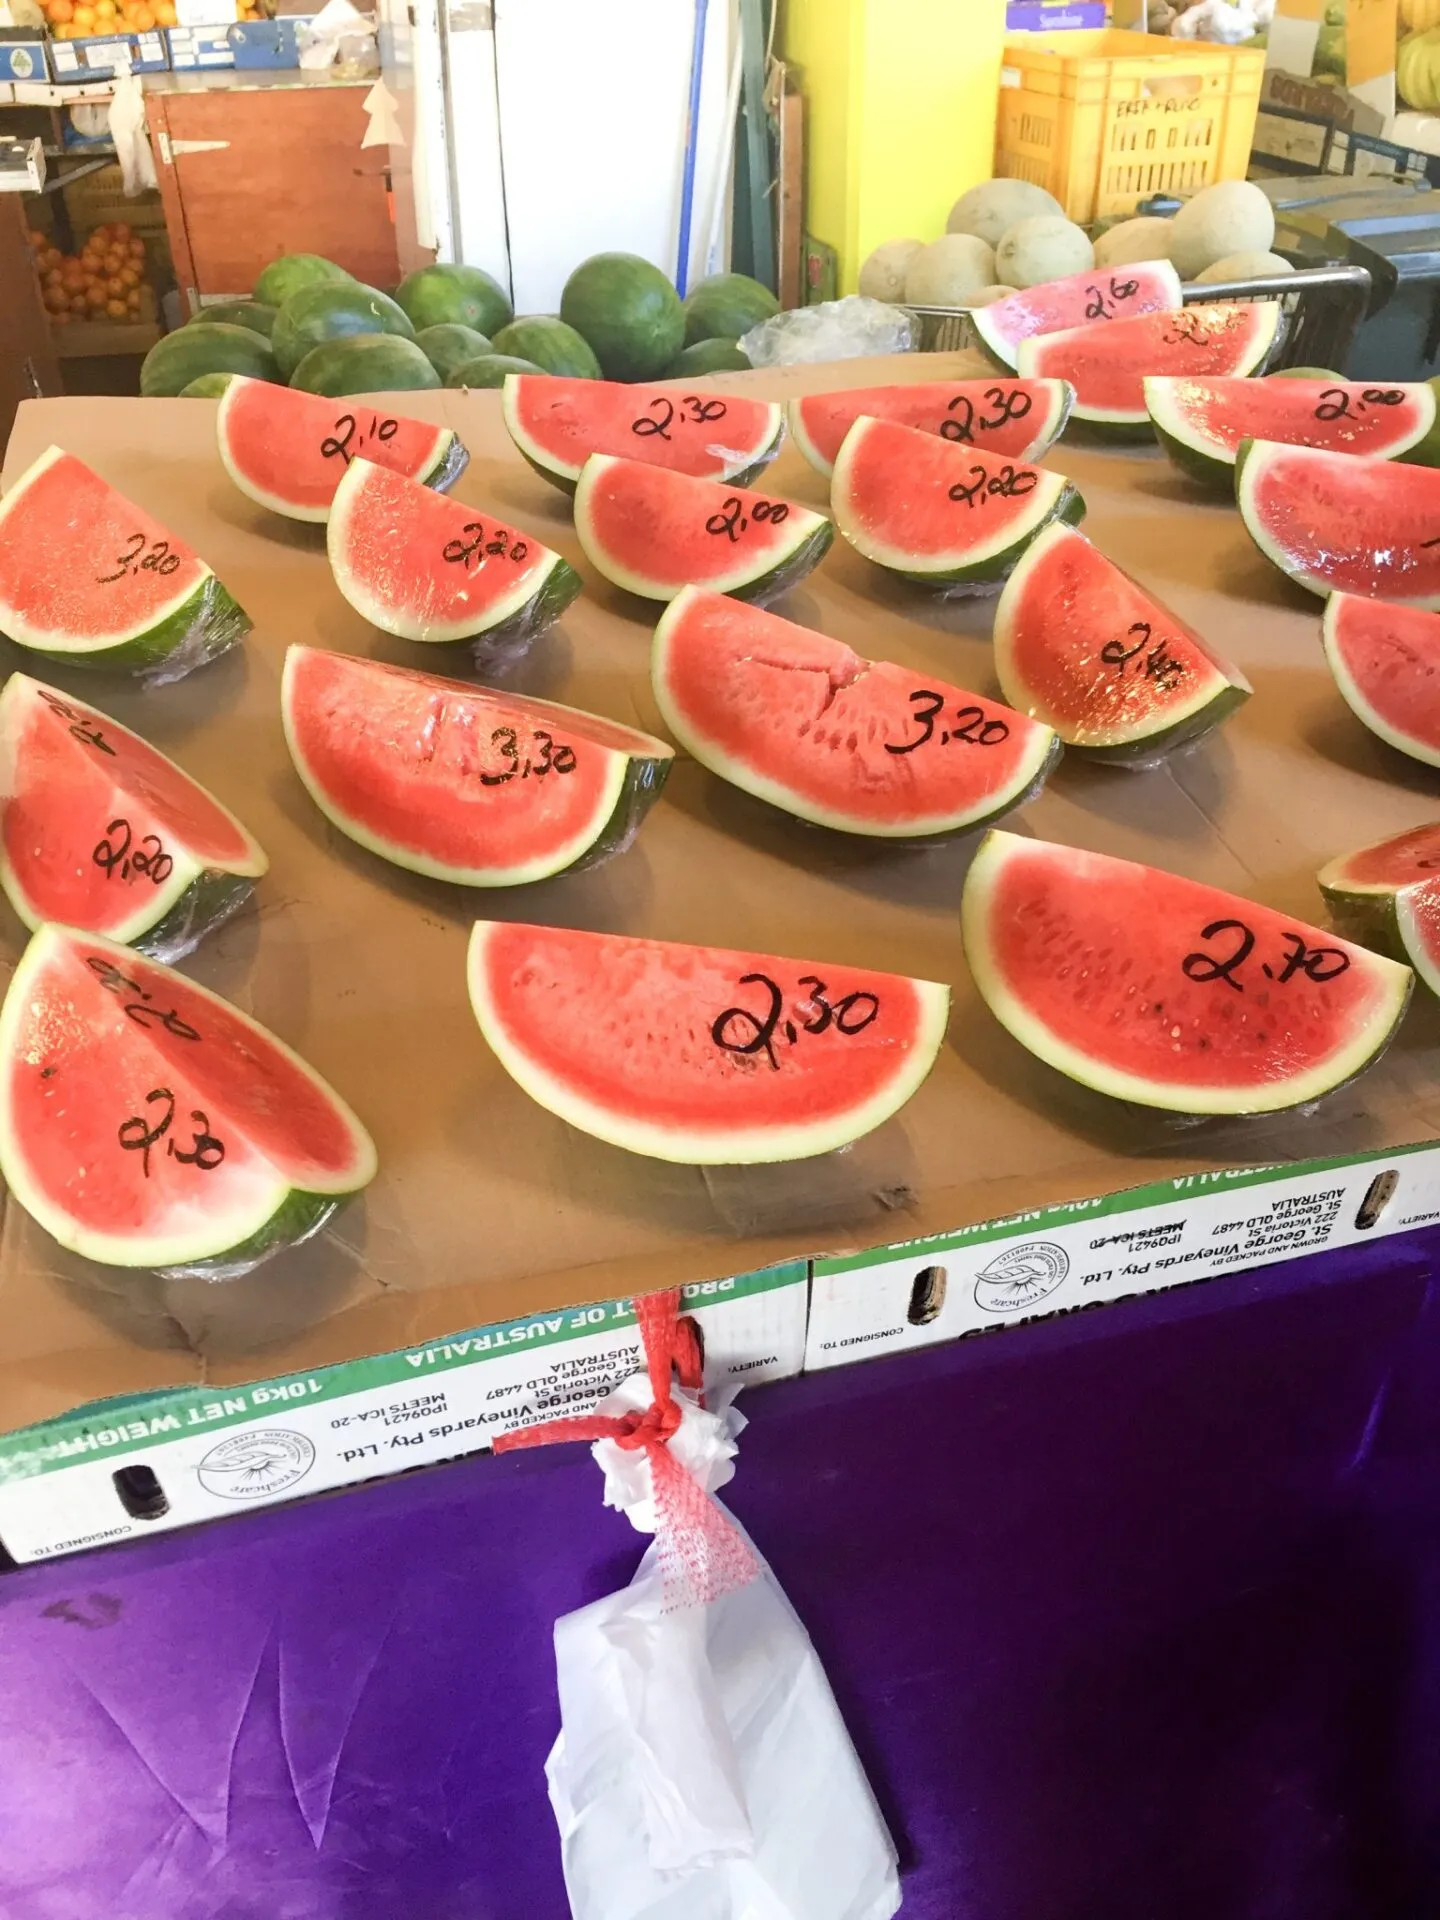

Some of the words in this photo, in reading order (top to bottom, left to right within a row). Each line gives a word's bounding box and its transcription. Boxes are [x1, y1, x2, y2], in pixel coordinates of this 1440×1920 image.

[1272, 1187, 1347, 1212] AUSTRALIA
[1326, 1199, 1342, 1210] St.
[1276, 1203, 1322, 1220] George
[1315, 1210, 1338, 1223] 222
[1211, 1221, 1244, 1235] 4487
[1246, 1214, 1273, 1228] QLD
[1264, 1216, 1312, 1233] Victoria
[1312, 1223, 1333, 1236] St.
[1244, 1229, 1306, 1250] George
[1248, 1227, 1262, 1237] St
[1128, 1233, 1181, 1253] IPQ9421
[1267, 1244, 1290, 1254] AND
[1290, 1235, 1328, 1247] GROWN
[1155, 1243, 1239, 1269] Vineyards
[1210, 1257, 1225, 1267] BY
[1225, 1249, 1266, 1263] PACKED
[1080, 1270, 1112, 1285] Ltd.
[1119, 1262, 1151, 1276] Pty.
[569, 1308, 606, 1330] OF
[404, 1316, 564, 1367] AUSTRALIA
[840, 1327, 904, 1347] CONSIGNED
[550, 1345, 640, 1372] AUSTRALIA
[621, 1355, 640, 1365] St.
[727, 1356, 779, 1374] VARIETY:
[561, 1361, 616, 1378] George
[527, 1375, 558, 1389] QLD
[554, 1372, 612, 1389] Victoria
[251, 1378, 323, 1405] 10kg
[486, 1384, 523, 1401] 4487
[535, 1387, 550, 1398] St
[537, 1386, 610, 1410] George
[187, 1397, 247, 1426] NET
[389, 1392, 446, 1414] MEETS
[573, 1401, 598, 1413] AND
[331, 1408, 385, 1430] ICA-20
[384, 1402, 448, 1427] IPQ9421
[429, 1405, 532, 1438] Vineyards
[522, 1408, 570, 1424] PACKED
[504, 1421, 519, 1430] BY
[384, 1432, 424, 1448] Pty.
[336, 1444, 379, 1462] Ltd.
[54, 1525, 132, 1551] CONSIGNED
